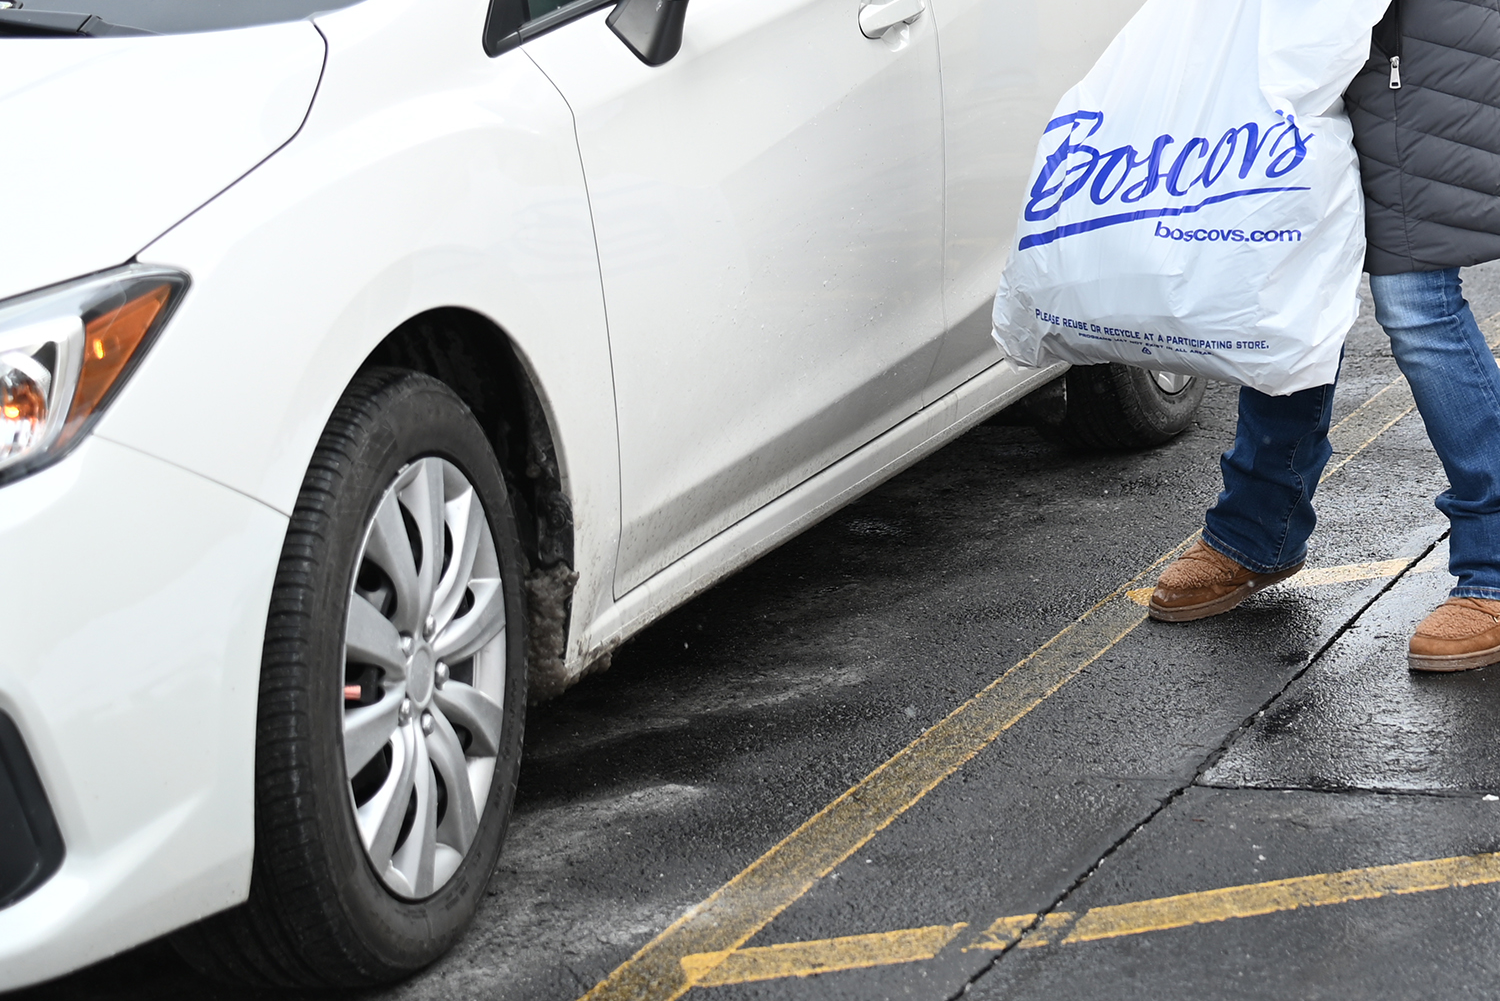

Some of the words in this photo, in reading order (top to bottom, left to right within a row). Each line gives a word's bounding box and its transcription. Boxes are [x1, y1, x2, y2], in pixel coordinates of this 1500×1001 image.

[1154, 221, 1302, 243] boscovs.com
[1035, 308, 1060, 325] PLEASE
[1063, 317, 1088, 331] REUSE
[1090, 323, 1102, 334] OR
[1103, 326, 1141, 340] RECYCLE
[1143, 332, 1154, 341] AT
[1157, 334, 1164, 343] A
[1166, 335, 1232, 350] PARTICIPATING
[1236, 340, 1270, 350] STORE.
